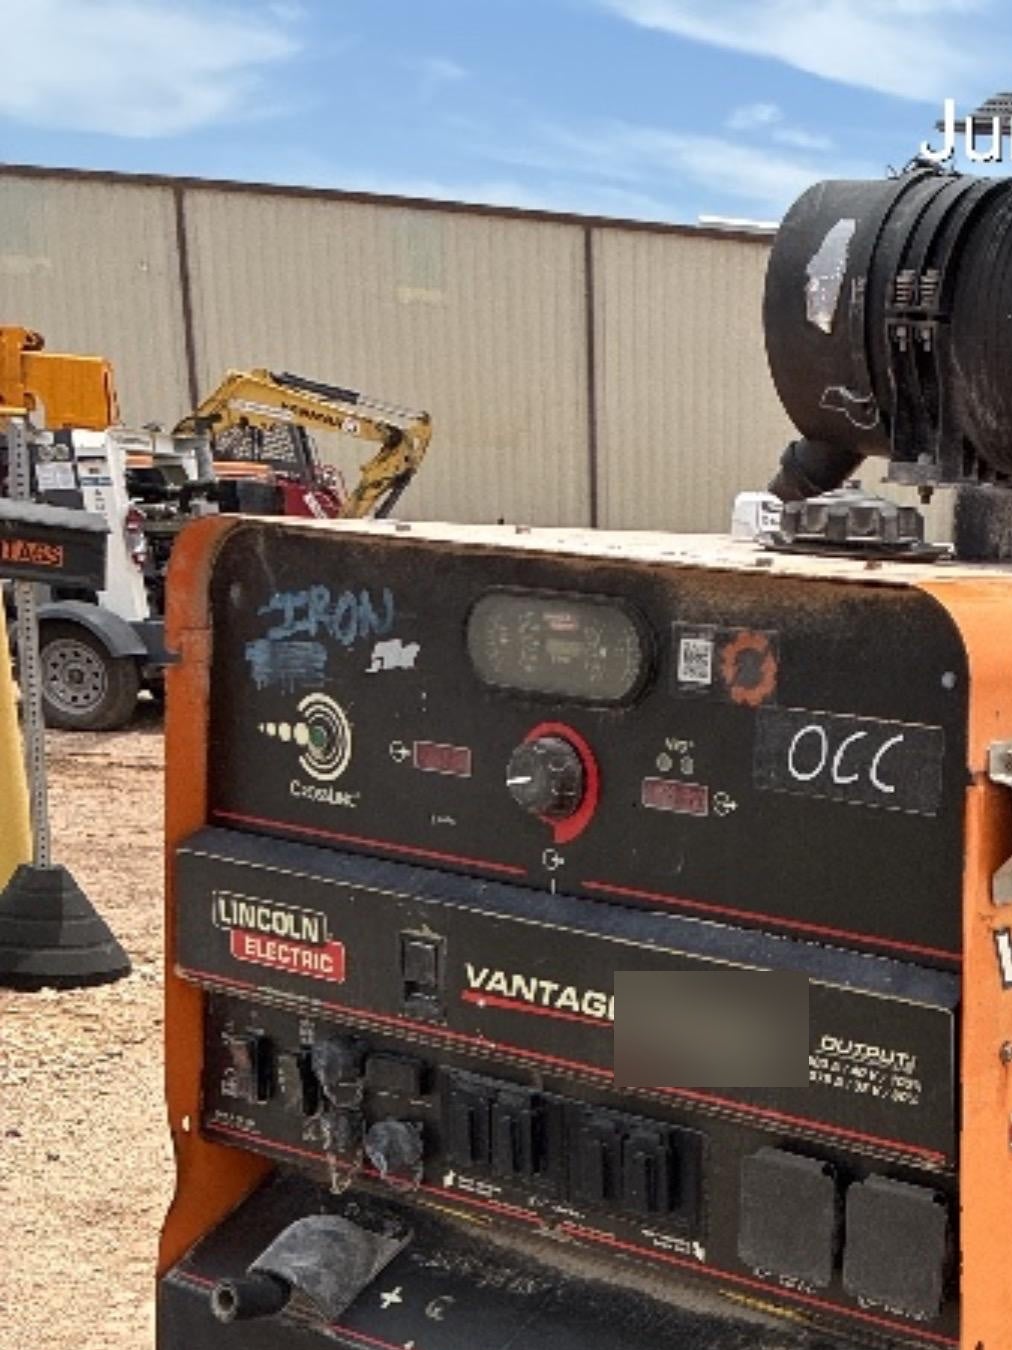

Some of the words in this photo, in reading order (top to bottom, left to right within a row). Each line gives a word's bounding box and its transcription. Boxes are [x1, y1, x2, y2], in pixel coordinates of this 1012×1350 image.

[257, 583, 393, 646] IRON
[219, 900, 319, 942] LINCOLN
[244, 937, 333, 974] ELECTRIC
[464, 964, 615, 1019] VANTAG
